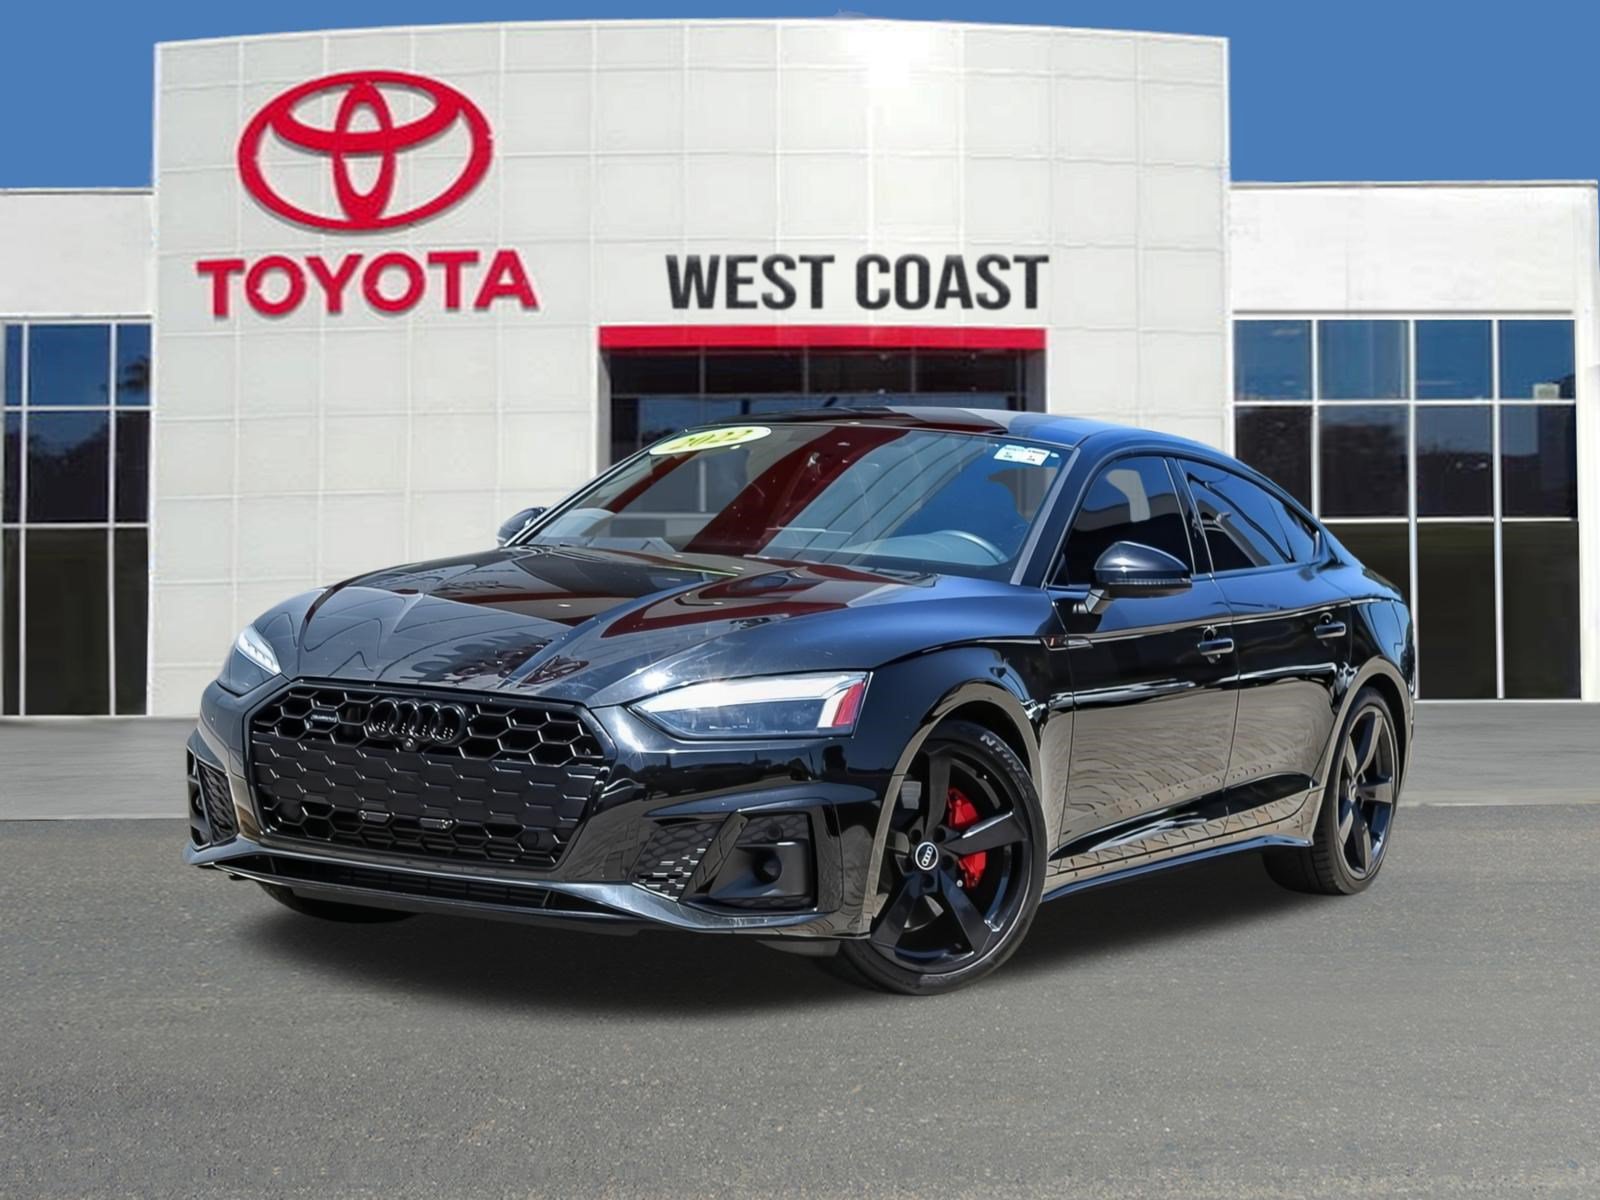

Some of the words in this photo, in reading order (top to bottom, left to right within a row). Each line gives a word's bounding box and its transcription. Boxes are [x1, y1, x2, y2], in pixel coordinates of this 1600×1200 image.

[196, 249, 539, 318] TOYOTA
[666, 253, 835, 310] WEST
[855, 253, 1050, 310] COAST
